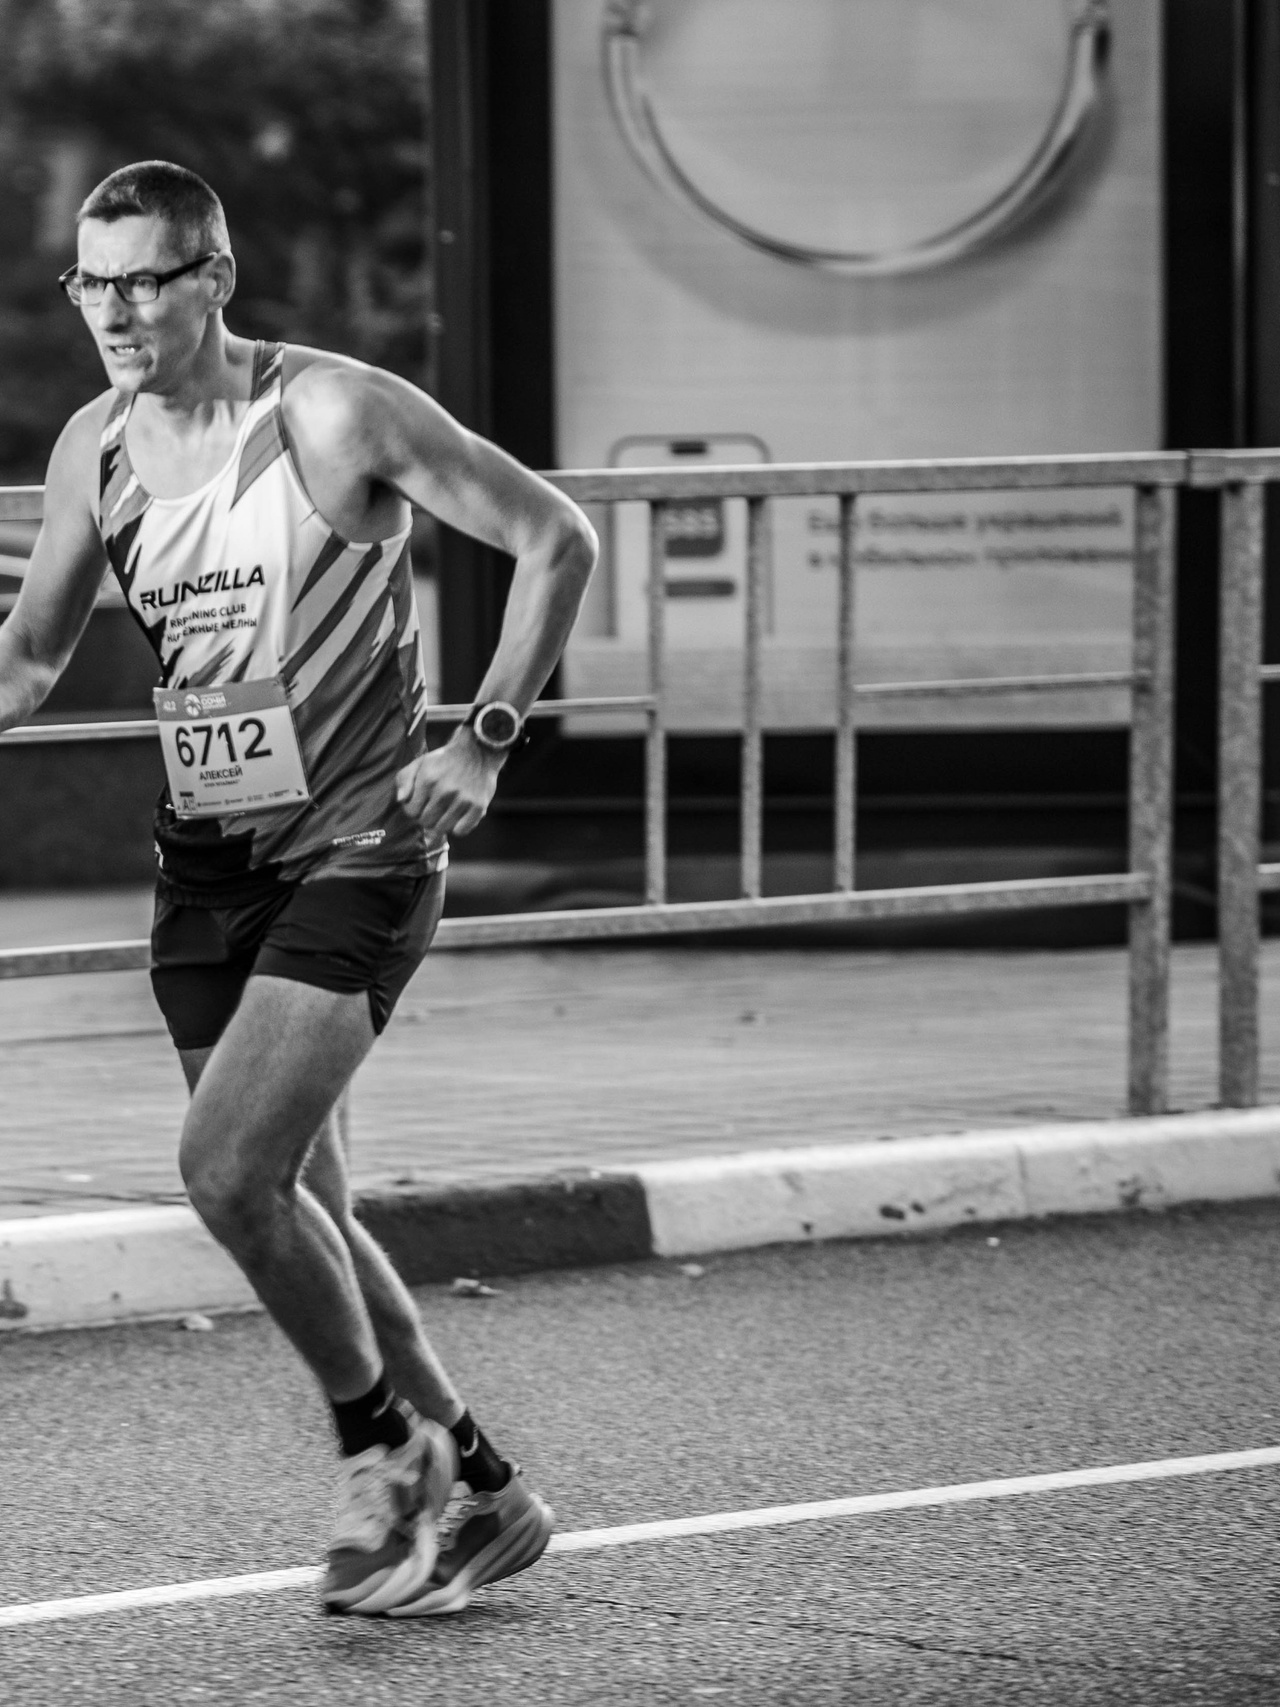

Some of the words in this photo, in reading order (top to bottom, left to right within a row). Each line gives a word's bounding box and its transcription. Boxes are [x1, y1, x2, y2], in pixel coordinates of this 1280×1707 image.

[140, 565, 265, 610] RUNZILLA
[220, 603, 247, 617] CLUB
[175, 717, 273, 768] 6712
[200, 765, 243, 780] АЛЕКСЕЙ
